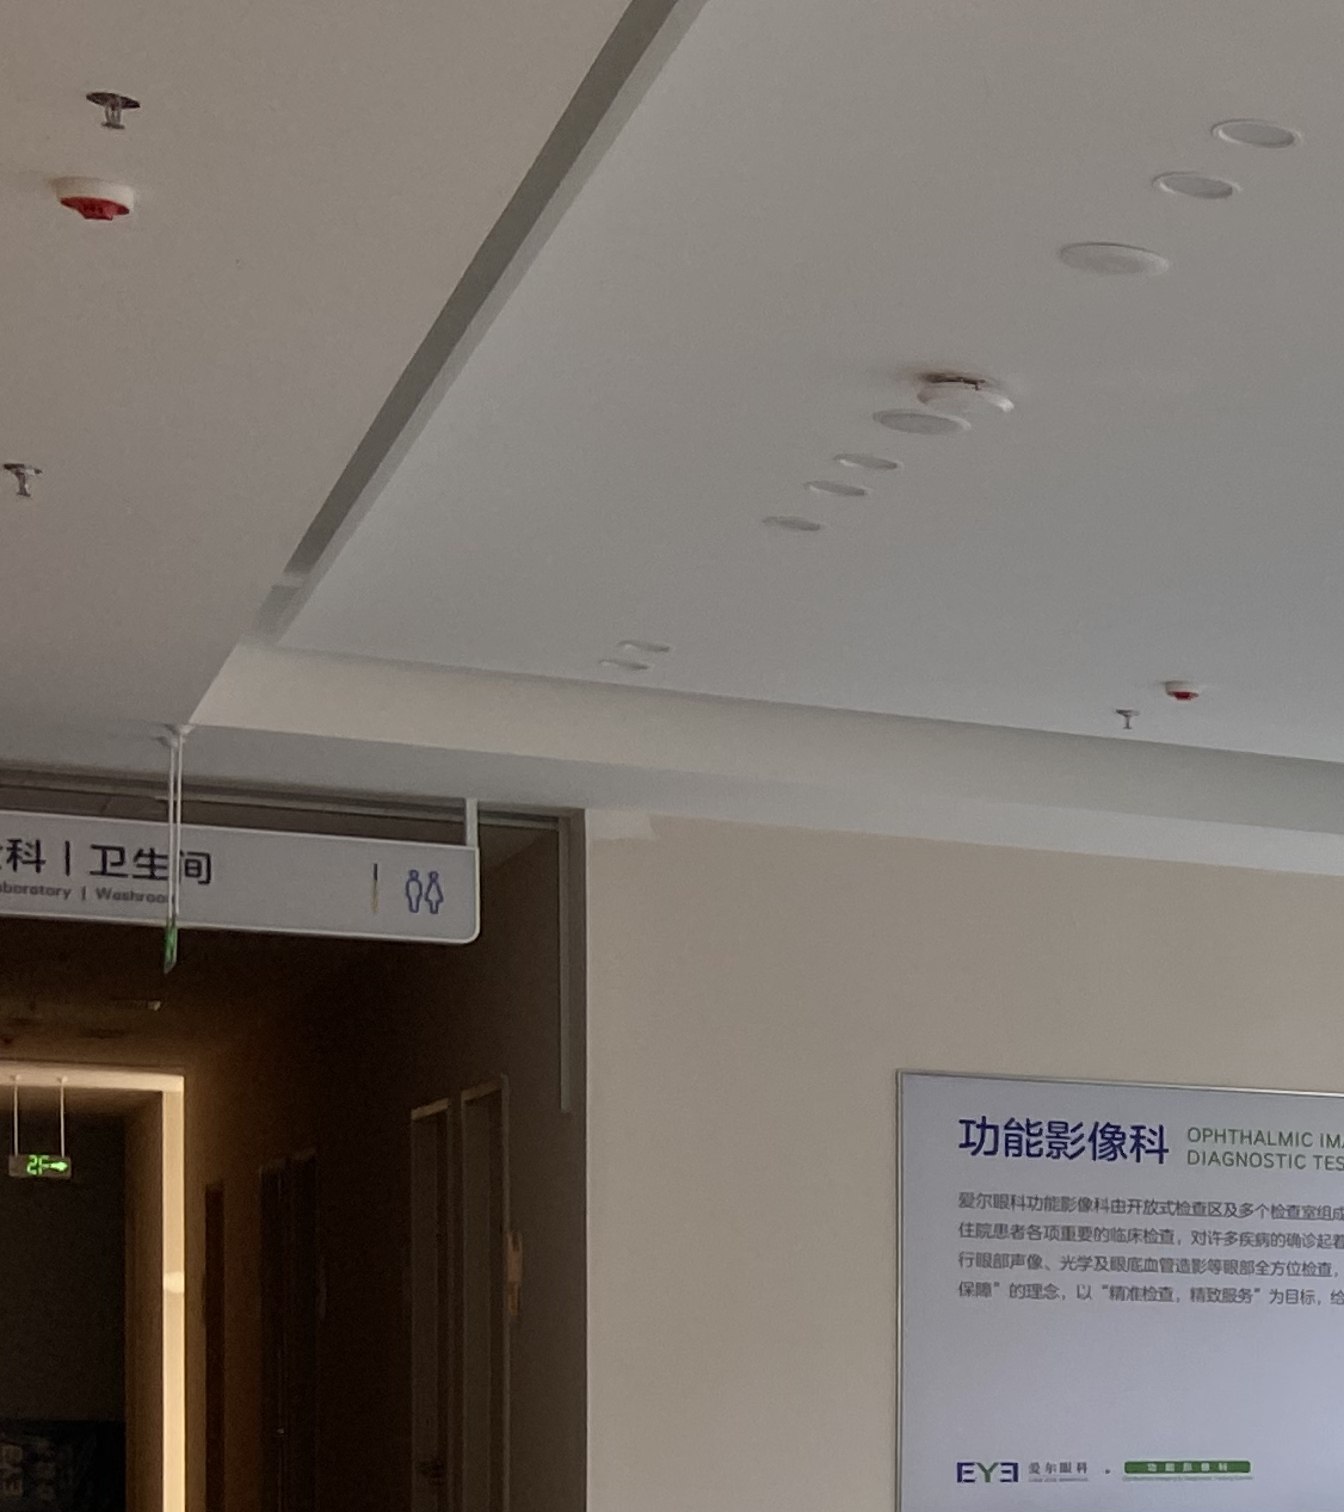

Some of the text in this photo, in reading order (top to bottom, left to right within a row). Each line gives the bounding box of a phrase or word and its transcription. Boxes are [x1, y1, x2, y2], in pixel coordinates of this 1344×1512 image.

[0, 838, 211, 885] 科 卫生间
[958, 1115, 1169, 1164] 功能影像科
[1187, 1126, 1313, 1148] OPHTHALMIC
[1187, 1149, 1306, 1170] DIAGNOSTIC
